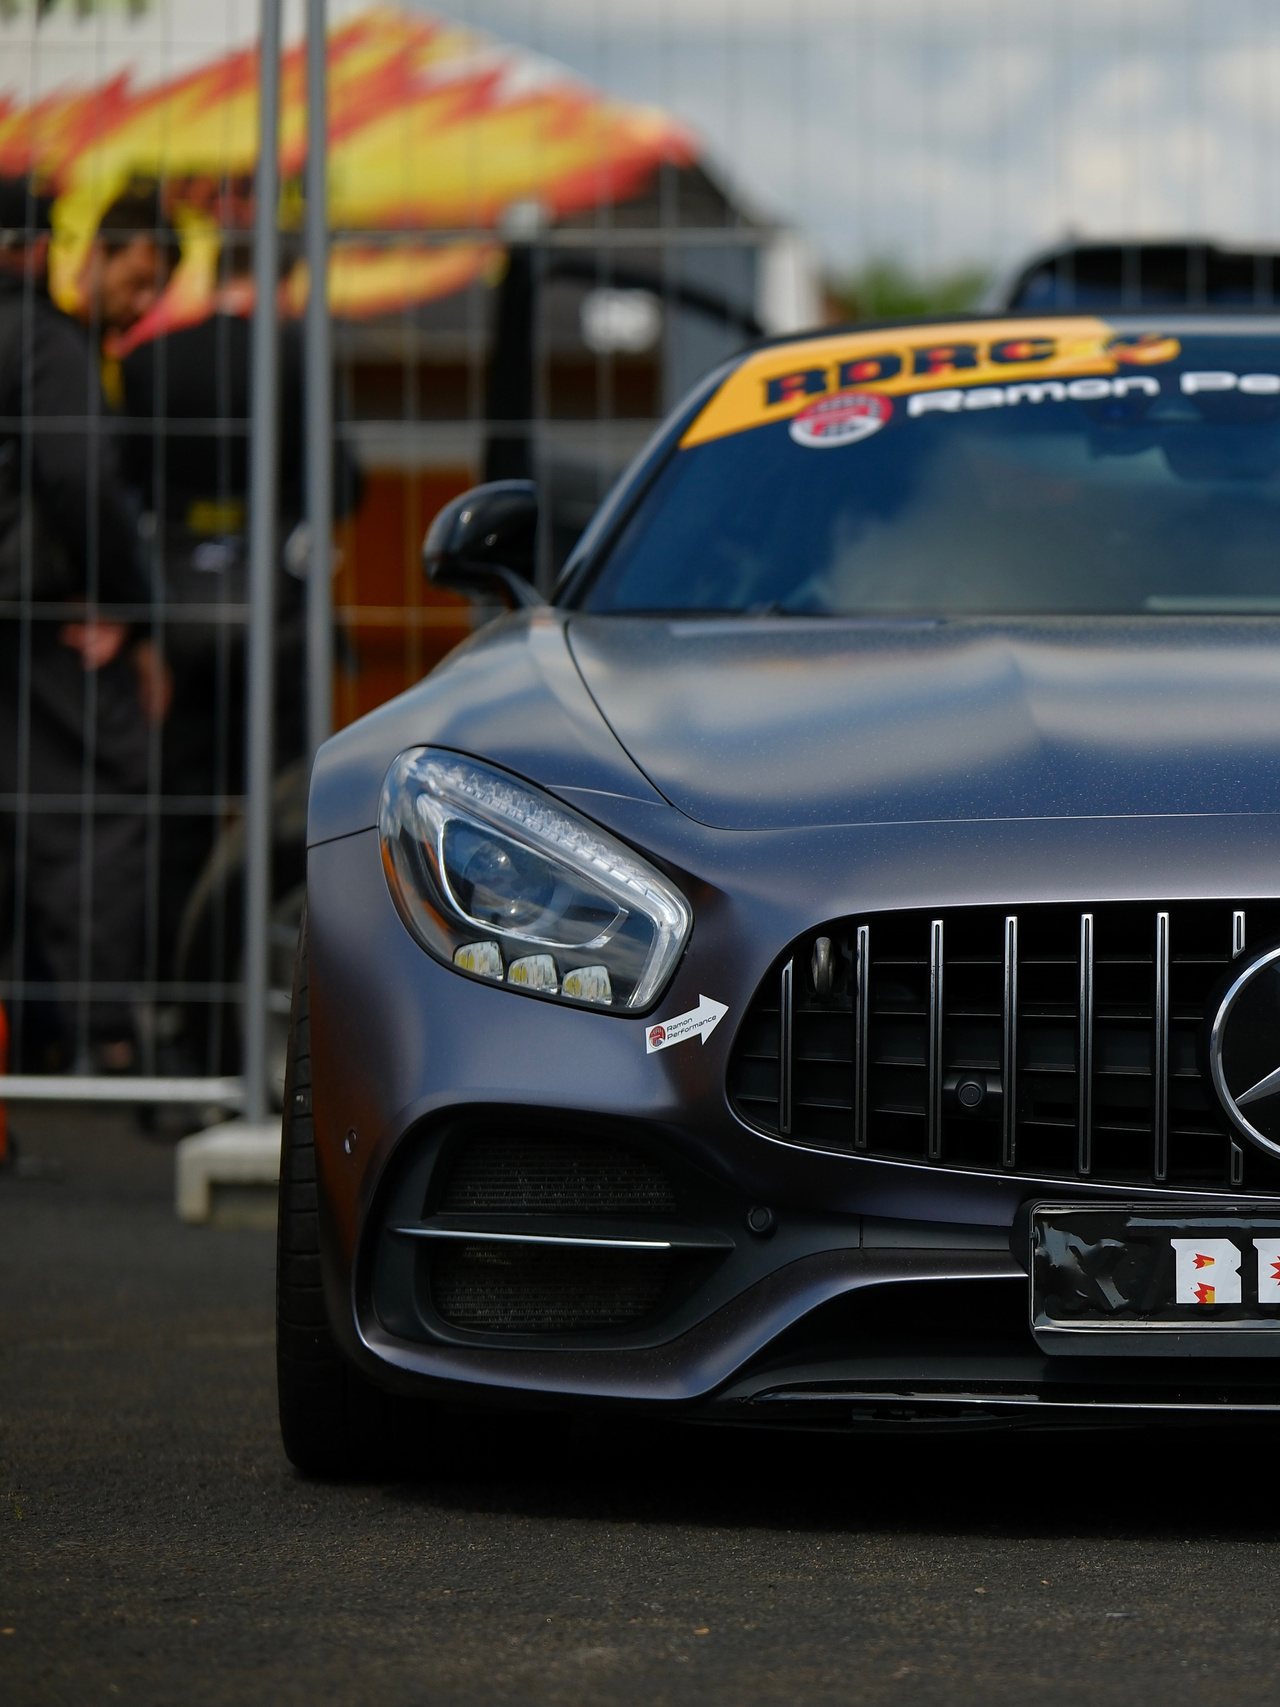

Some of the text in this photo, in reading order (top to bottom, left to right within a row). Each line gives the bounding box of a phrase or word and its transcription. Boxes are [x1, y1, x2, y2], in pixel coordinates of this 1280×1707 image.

[763, 337, 1056, 407] RDRC
[906, 375, 1160, 418] Ramon
[666, 1017, 693, 1032] Ramon
[667, 1015, 717, 1040] Performance
